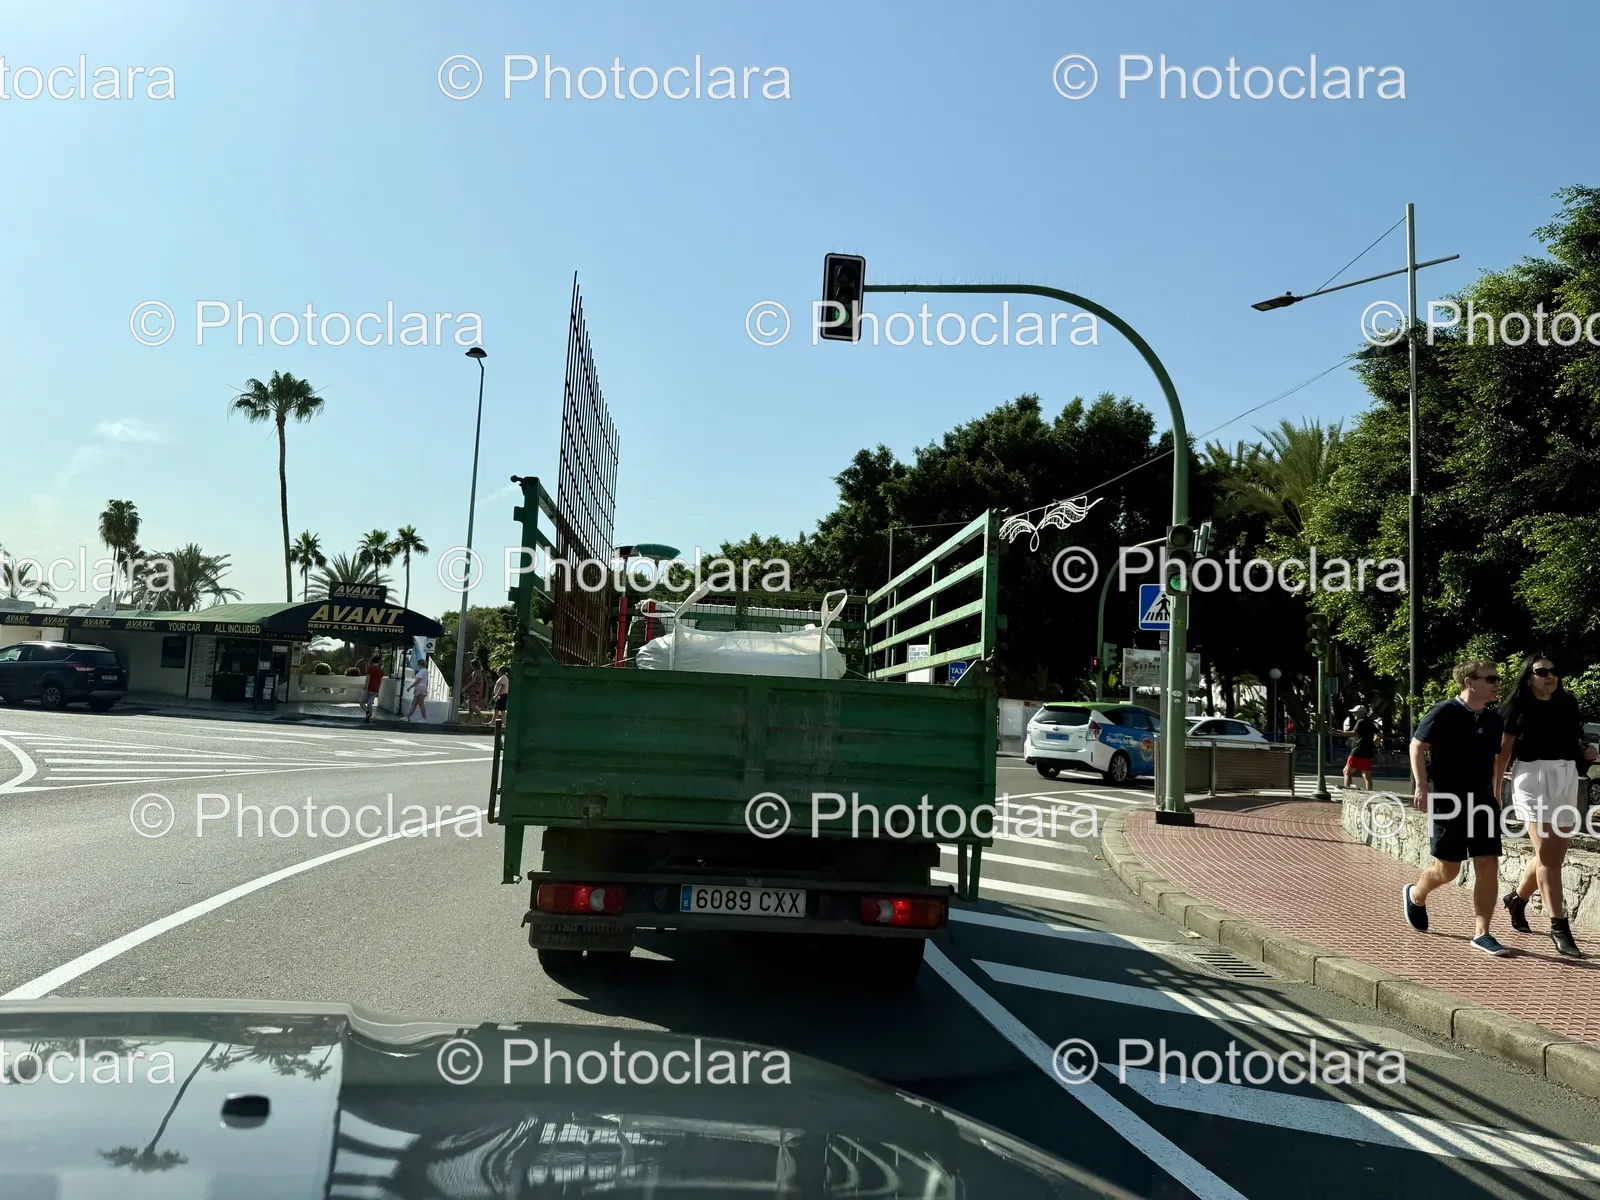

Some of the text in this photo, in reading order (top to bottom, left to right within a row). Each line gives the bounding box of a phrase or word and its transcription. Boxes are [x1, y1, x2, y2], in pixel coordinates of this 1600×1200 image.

[335, 585, 380, 595] AVANT
[5, 614, 30, 622] AVANT
[310, 605, 404, 624] AVANT
[42, 616, 69, 624] AVANT
[83, 618, 112, 626] AVANT
[168, 622, 201, 632] YOUR CAR
[214, 623, 261, 634] ALL INCLUDED
[366, 626, 404, 634] RENTING
[696, 889, 800, 914] 6089 CXX
